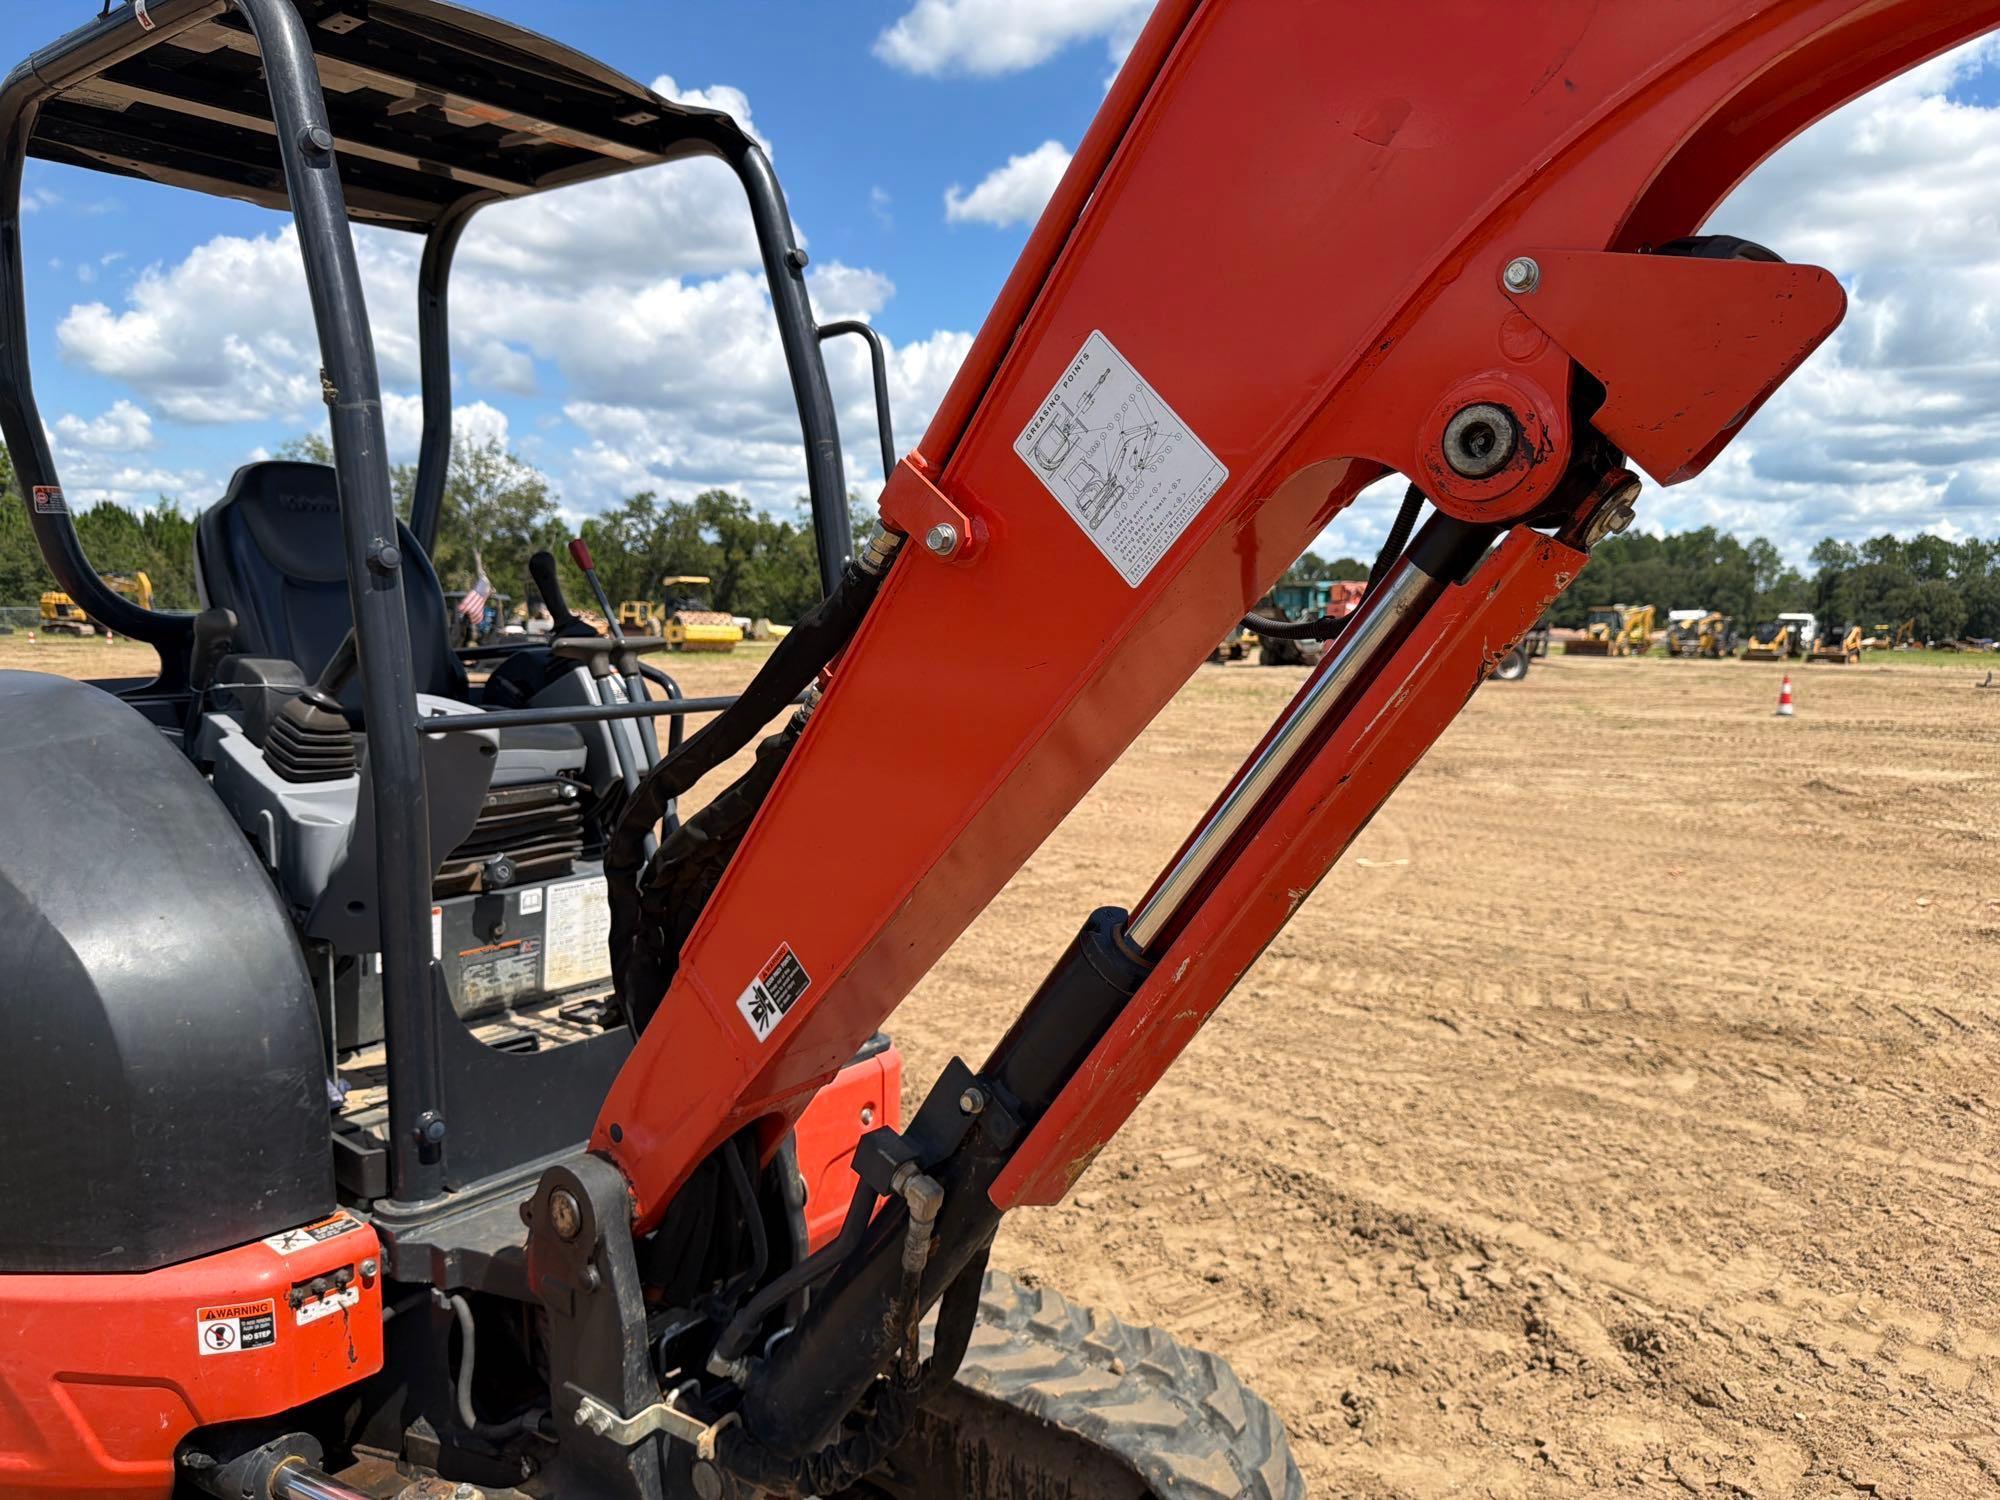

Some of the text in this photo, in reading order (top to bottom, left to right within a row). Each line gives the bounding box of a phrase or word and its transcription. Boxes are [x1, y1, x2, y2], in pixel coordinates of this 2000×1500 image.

[1025, 351, 1090, 442] GREASING POINTS
[216, 1303, 268, 1318] WARNING
[243, 1329, 272, 1341] NO STEP
